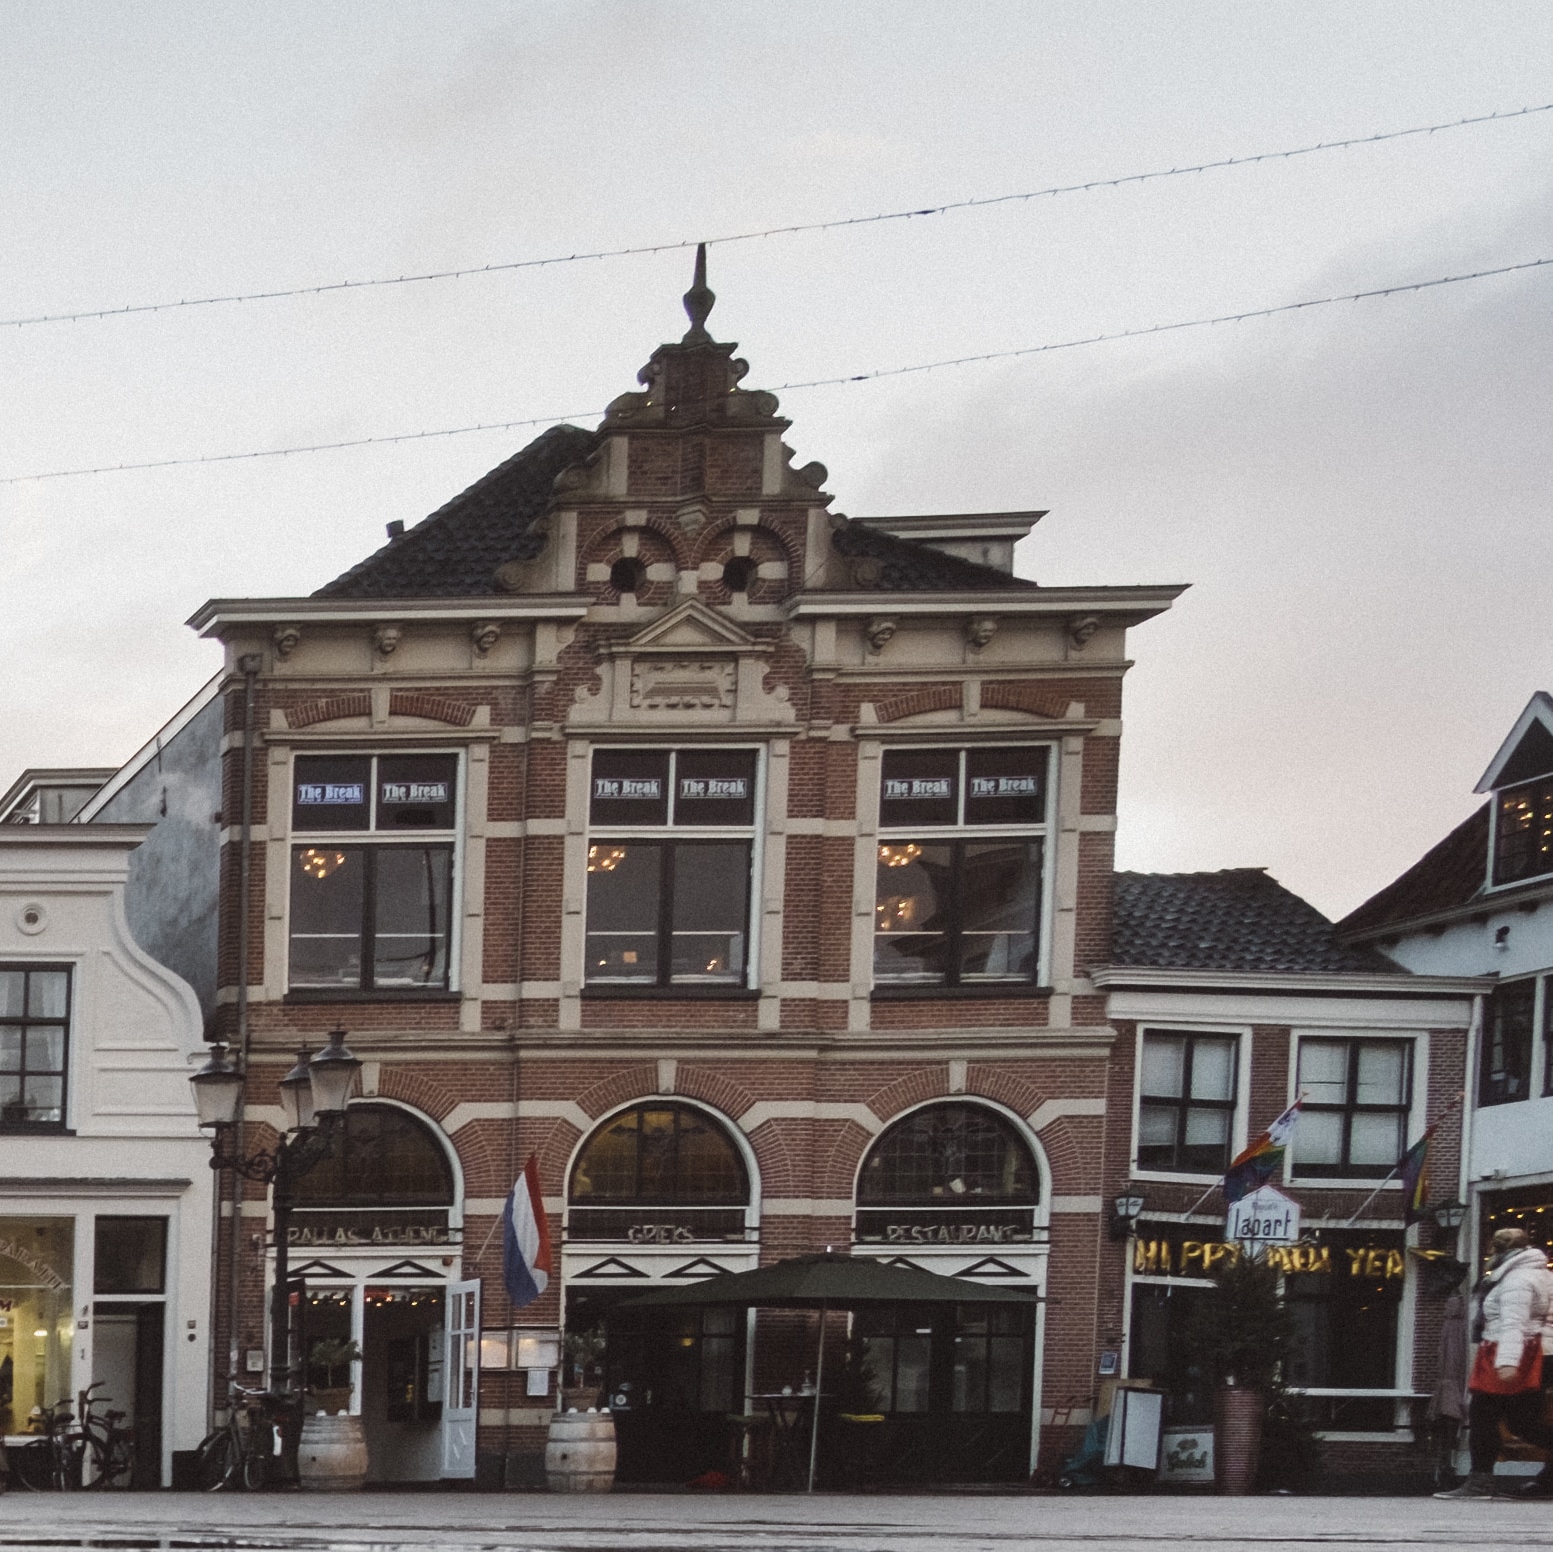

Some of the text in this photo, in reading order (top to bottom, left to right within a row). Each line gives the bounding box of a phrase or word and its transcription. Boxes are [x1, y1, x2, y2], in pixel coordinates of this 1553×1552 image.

[299, 784, 361, 799] The Break
[384, 784, 446, 799] The Break
[596, 780, 658, 795] The Break
[683, 779, 745, 795] The Break
[886, 780, 948, 795] The Break
[973, 777, 1035, 793] The Break
[628, 1225, 694, 1244] GRIEKS
[886, 1225, 1019, 1243] RESTAURANT
